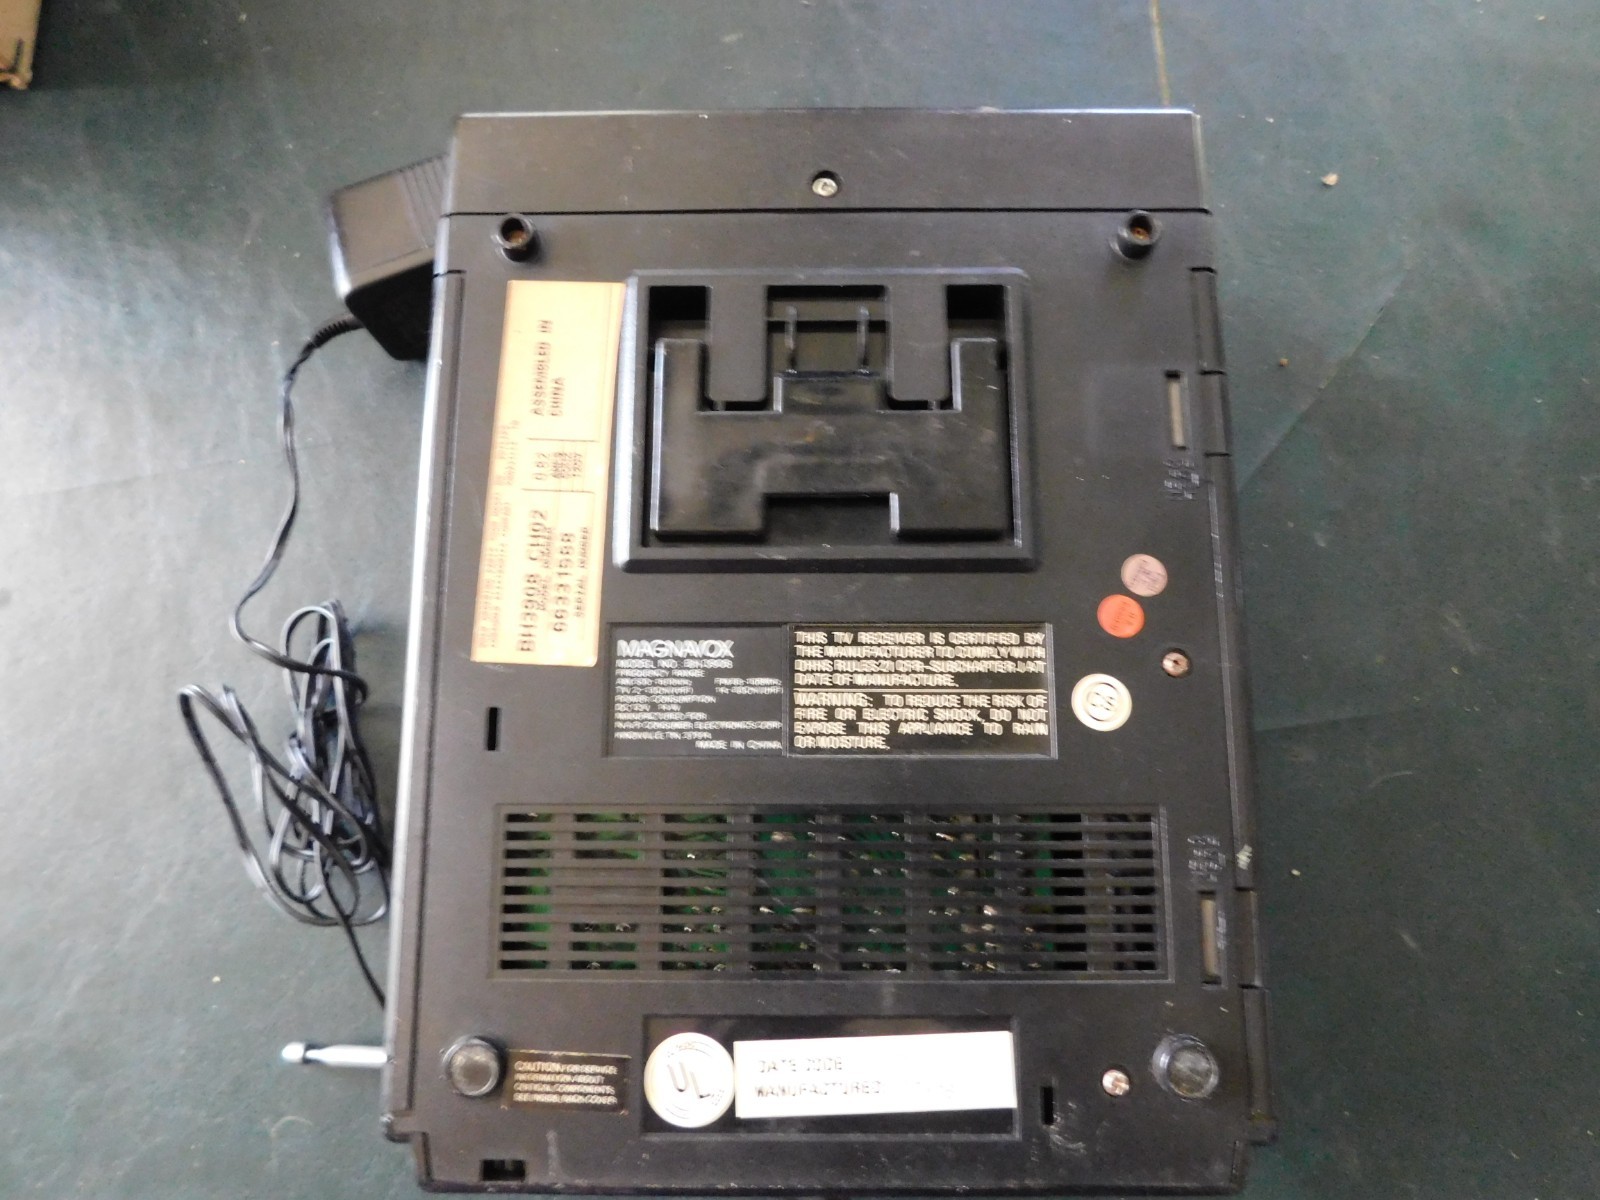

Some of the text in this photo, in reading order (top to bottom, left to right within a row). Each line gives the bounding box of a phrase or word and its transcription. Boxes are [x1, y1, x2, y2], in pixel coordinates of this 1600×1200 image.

[531, 319, 553, 417] ASSEMBLED IN
[548, 377, 565, 418] CHINA
[536, 526, 556, 611] MODEL NUMBER
[573, 526, 590, 618] SERIAL NUMBER
[516, 509, 548, 652] BH3908 CH02
[794, 631, 1045, 645] THIS TV RECEIVER IS CERTIFIED BY
[616, 639, 735, 658] MAGNAVOX
[794, 645, 1045, 659] THE MANUFACTURER TO COMPLY WITH
[834, 659, 877, 673] RULES
[794, 673, 960, 687] DATE OF MANUFACTURE.
[794, 692, 1048, 707] WARNING: TO REDUCE THE RISK OF
[794, 708, 1048, 724] FIRE OR ELECTRIC SHOCK, DO NOT
[794, 722, 1049, 736] EXPOSE THIS APPLIANCE TO RAIN
[695, 740, 783, 750] MADE IN CHINA
[794, 736, 891, 750] OR MOISTURE.
